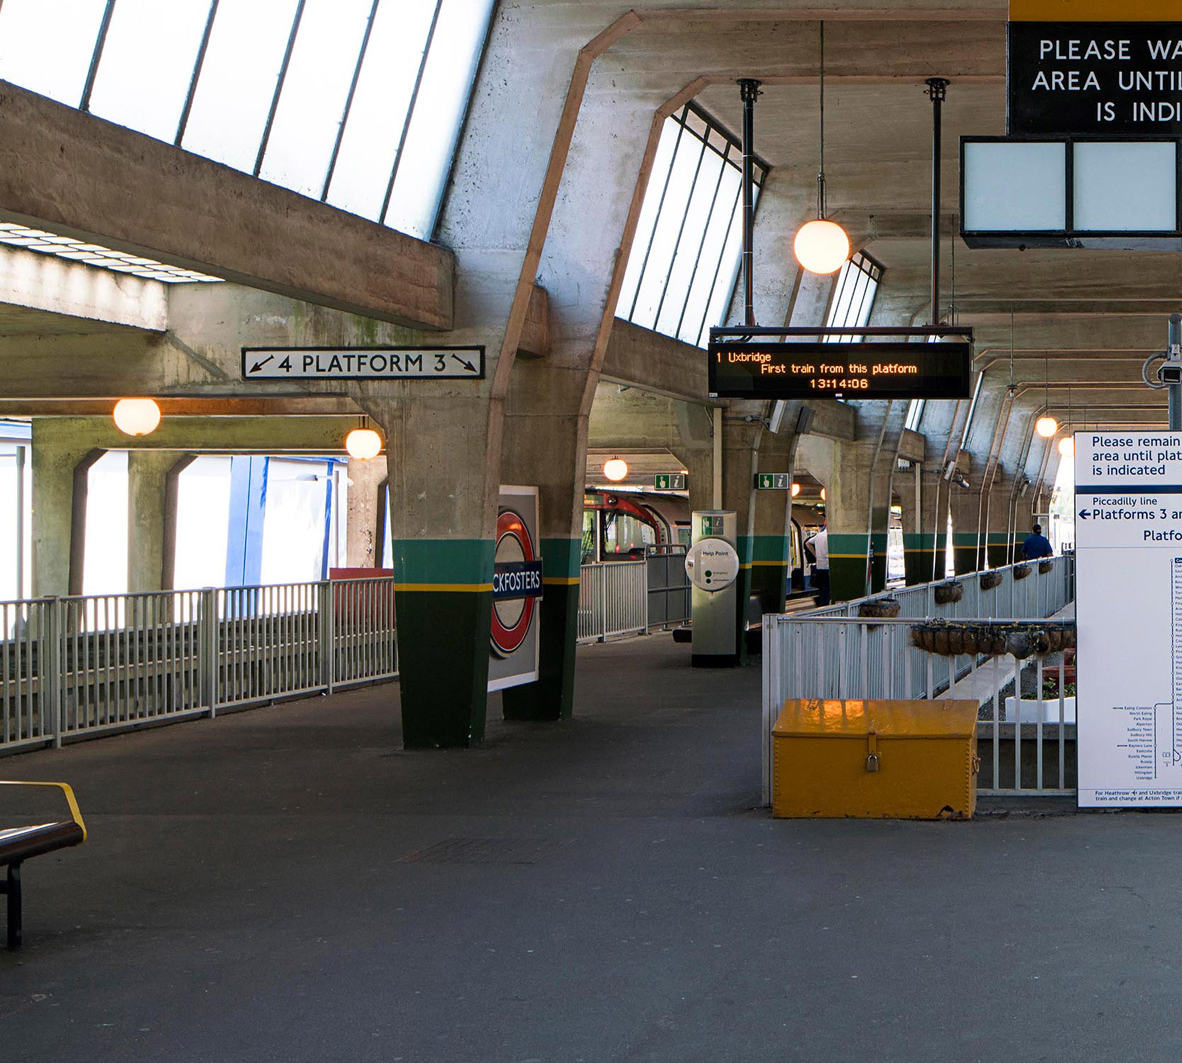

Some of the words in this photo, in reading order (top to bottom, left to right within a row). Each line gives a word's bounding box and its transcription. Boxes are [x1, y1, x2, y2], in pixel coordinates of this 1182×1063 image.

[1040, 40, 1131, 60] PLEASE
[1032, 71, 1100, 91] AREA
[1097, 102, 1115, 122] IS
[278, 355, 292, 372] 4
[303, 354, 423, 372] PLATFORM
[434, 354, 446, 371] 3
[716, 352, 721, 363] 1
[728, 353, 772, 363] Uxbridge
[761, 364, 786, 374] First
[791, 364, 815, 374] train
[820, 364, 844, 374] from
[849, 364, 868, 374] this
[872, 364, 917, 375] platform
[810, 379, 868, 389] 13:14:06
[1092, 436, 1133, 447] Please
[1138, 438, 1180, 446] remain
[1092, 452, 1119, 461] area
[1124, 451, 1153, 461] until
[1092, 465, 1102, 475] is
[1107, 465, 1165, 475] indicated
[1093, 497, 1137, 507] Piccadilly
[1140, 497, 1157, 505] line
[1093, 509, 1155, 520] Platforms
[1160, 509, 1167, 520] 3
